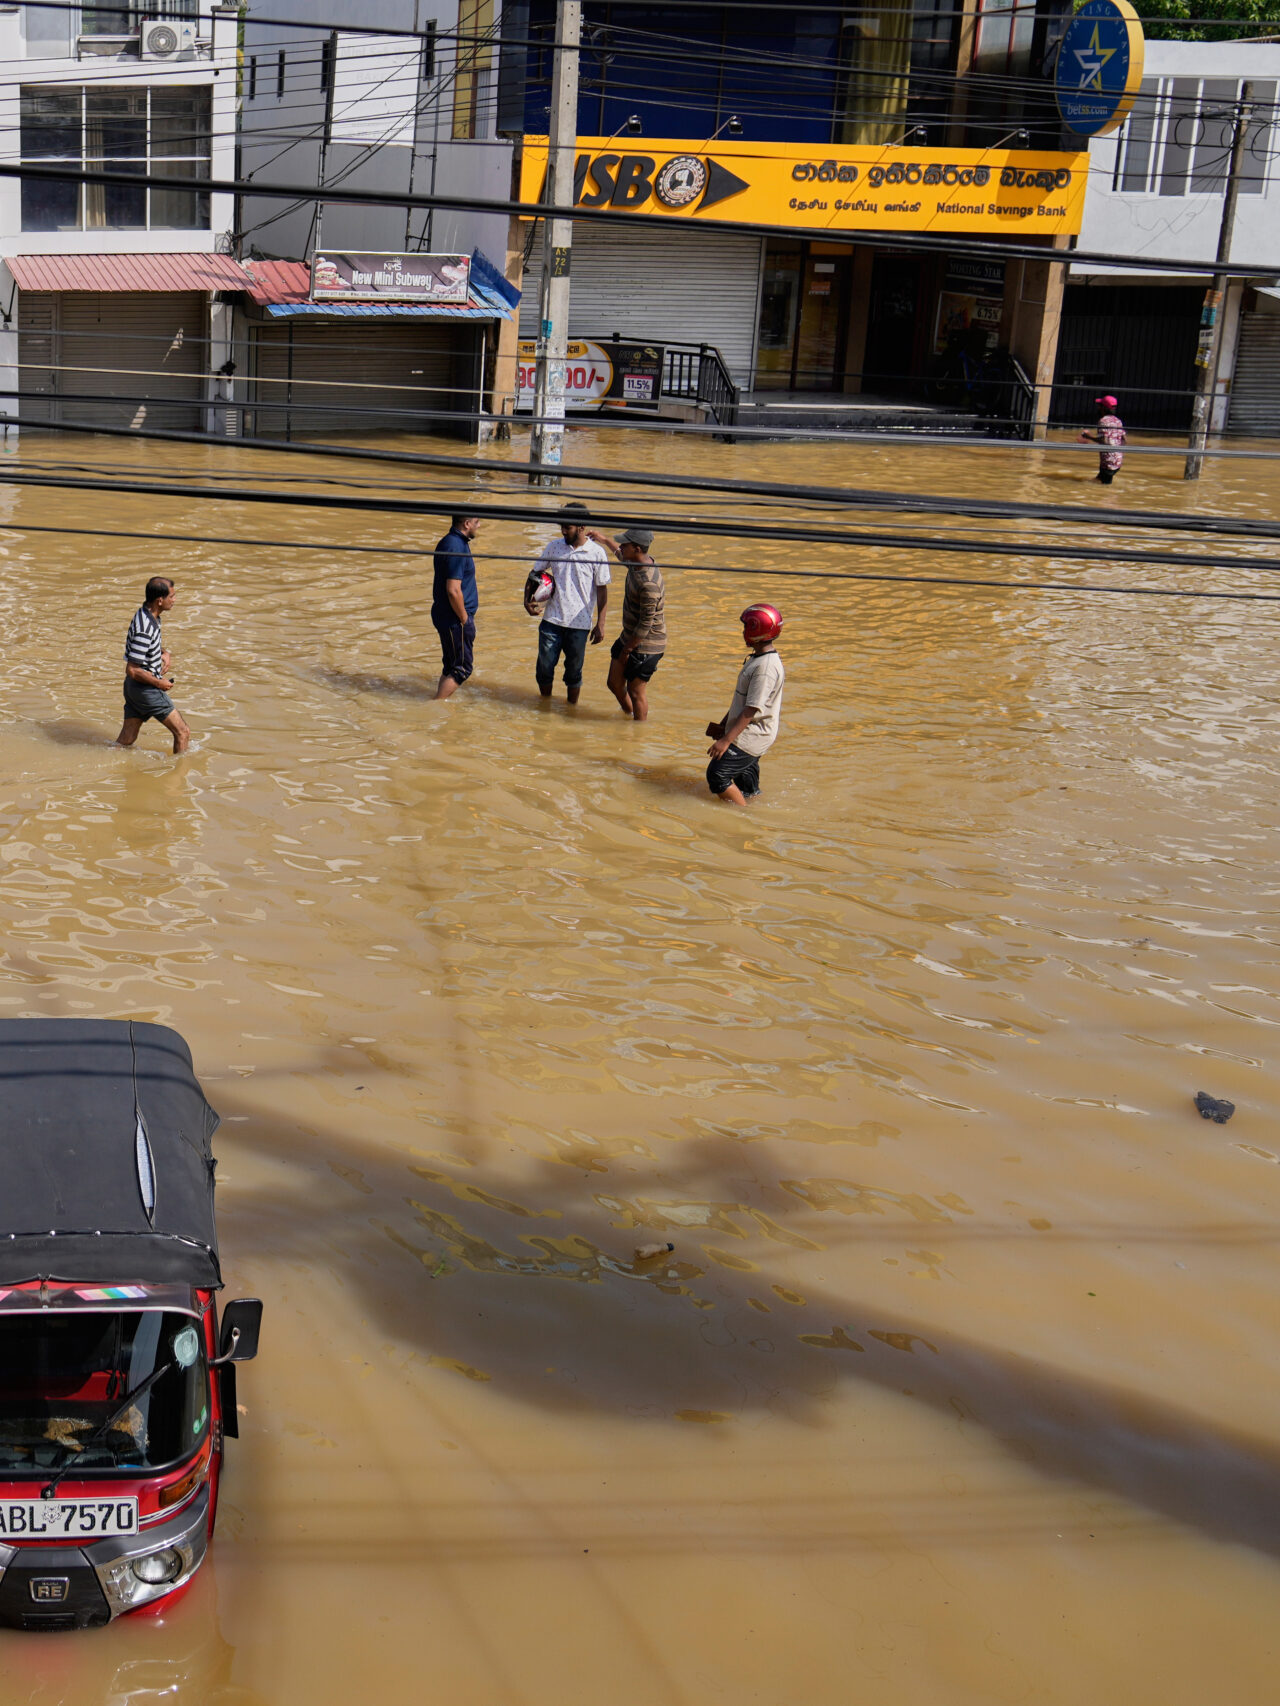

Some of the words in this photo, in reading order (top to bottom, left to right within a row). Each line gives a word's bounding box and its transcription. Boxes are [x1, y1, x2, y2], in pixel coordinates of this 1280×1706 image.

[792, 160, 858, 183] ජාතික
[1000, 166, 1072, 192] බැංකුව
[788, 198, 828, 212] தேசிய
[834, 199, 878, 214] சேமிப்பு
[884, 200, 921, 213] வங்கி
[936, 202, 985, 215] National
[987, 203, 1034, 219] Savings
[1036, 205, 1067, 217] Bank
[555, 257, 567, 266] 72
[352, 270, 373, 286] New
[374, 271, 394, 287] Mini
[395, 272, 433, 291] Subway
[626, 378, 651, 391] 11.5%
[60, 1502, 134, 1532] 7570
[37, 1585, 63, 1598] RE
